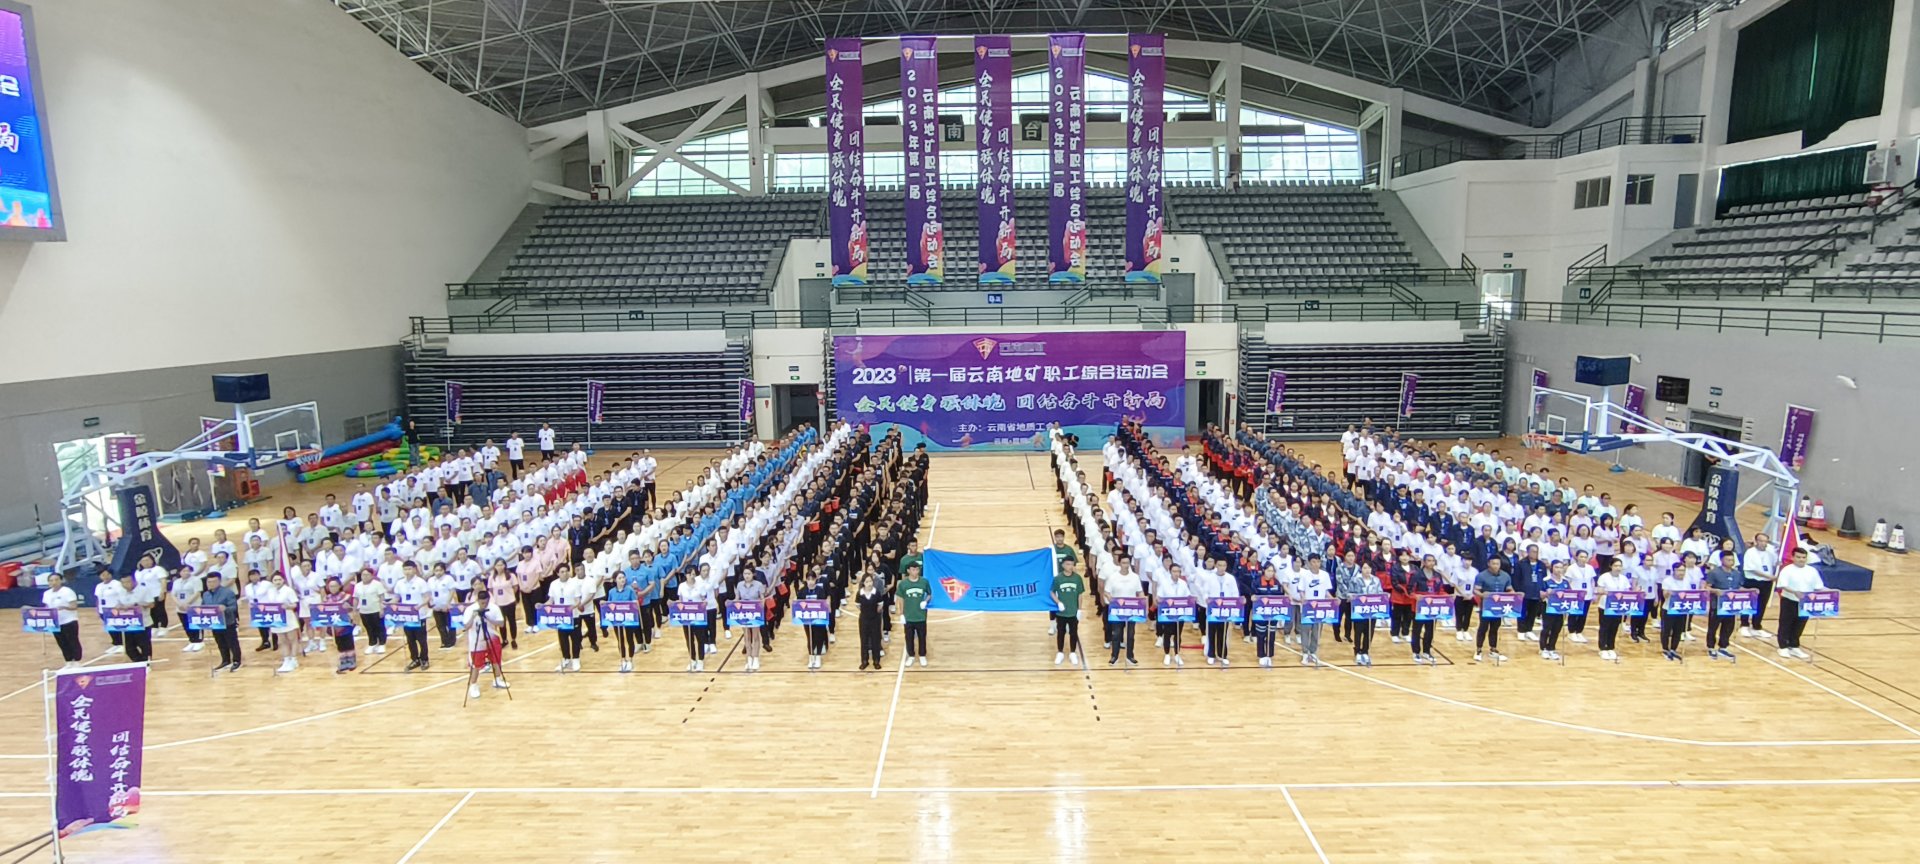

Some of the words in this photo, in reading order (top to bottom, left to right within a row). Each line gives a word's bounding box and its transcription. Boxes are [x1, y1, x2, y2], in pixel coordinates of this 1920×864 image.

[829, 73, 848, 207] 全民健身强体魄
[907, 70, 921, 200] 2023年第一届
[947, 122, 962, 139] 南
[978, 70, 995, 205] 全民健身强体魄
[1053, 67, 1065, 197] 2023年第一届
[1129, 68, 1146, 204] 全民健身强体魄
[849, 130, 865, 263] 团结奋斗开新局
[997, 127, 1012, 259] 团结奋斗开新局
[1146, 127, 1161, 259] 团结奋斗开新局
[852, 367, 896, 385] 2023
[914, 365, 1169, 383] 第一届云南地矿职工综合运动会
[854, 392, 1006, 413] 全民健身强体魄
[1017, 390, 1167, 411] 团结奋斗开新局
[133, 493, 152, 542] 金陵体育
[1705, 473, 1722, 524] 金陵体育
[255, 613, 283, 623] 二大队
[318, 613, 342, 623] 二水
[1491, 603, 1514, 615] 一水
[1551, 600, 1580, 610] 一大队
[1610, 601, 1640, 611] 三大队
[1673, 600, 1702, 610] 五大队
[70, 694, 94, 781] 全民健身强体魄
[109, 731, 132, 817] 团结奋斗开新局
